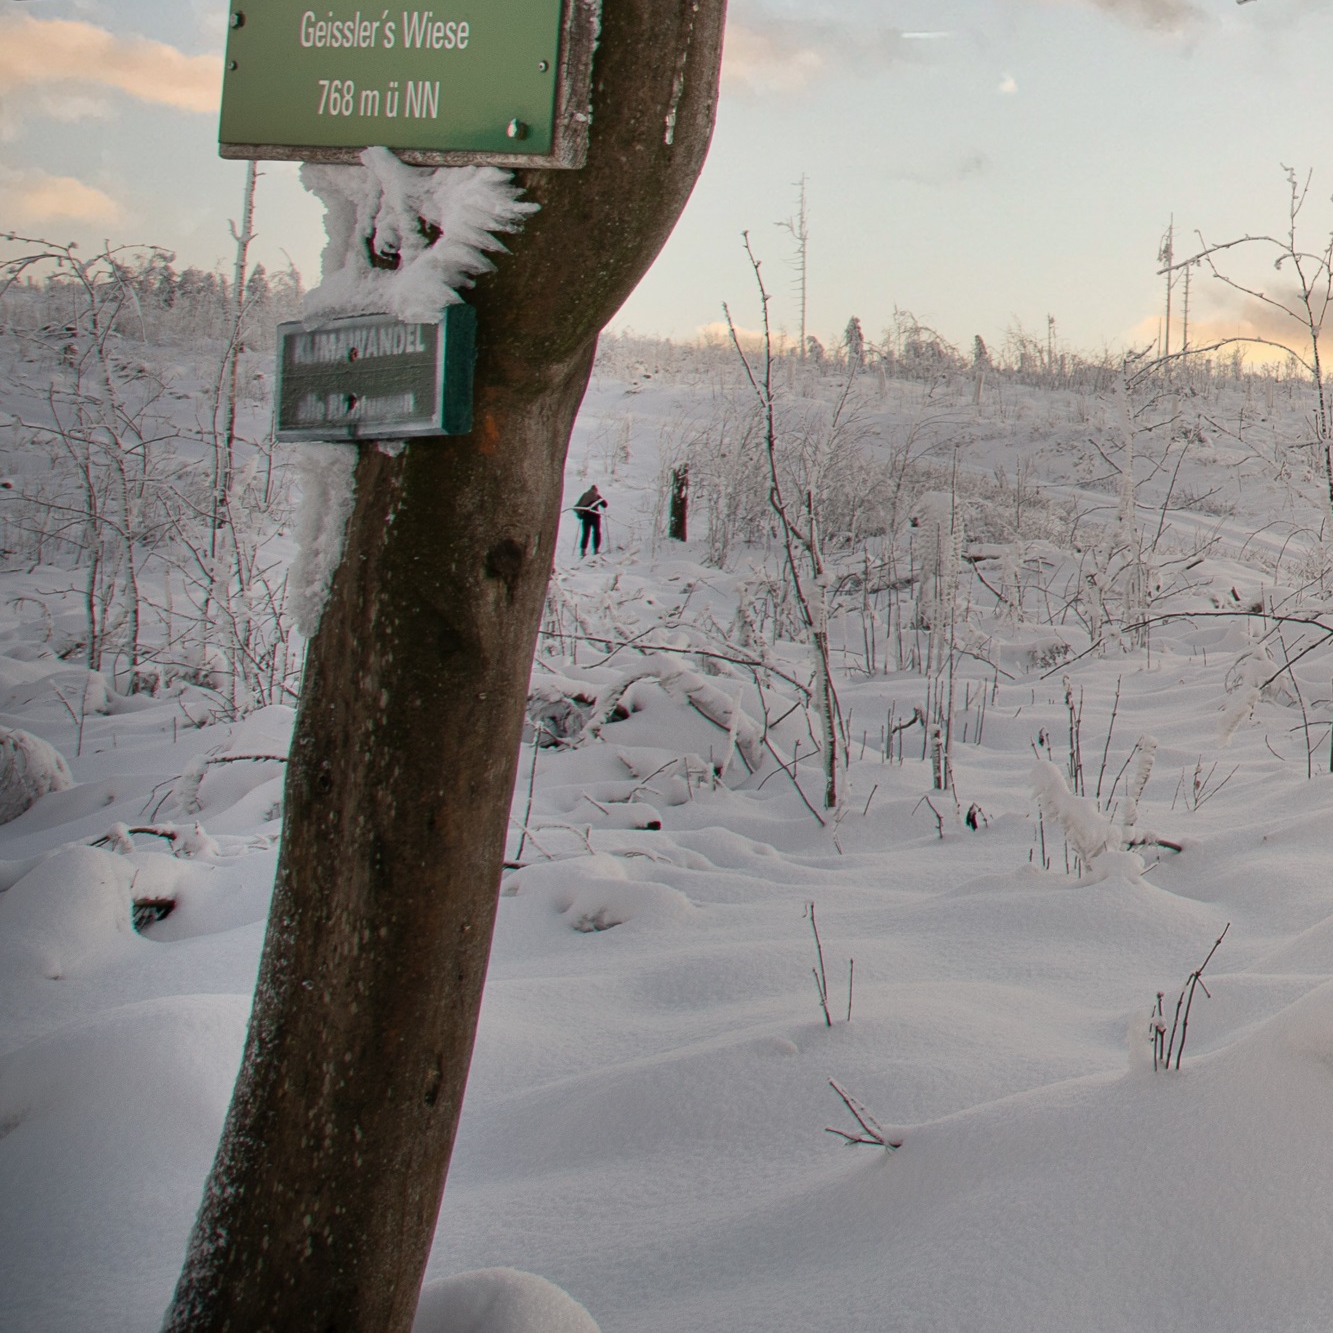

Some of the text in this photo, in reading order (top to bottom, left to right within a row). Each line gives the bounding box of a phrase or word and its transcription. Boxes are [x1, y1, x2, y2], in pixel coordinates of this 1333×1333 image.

[402, 10, 470, 50] Wiese
[316, 78, 441, 119] 768 m ü NN
[294, 324, 425, 364] KLIMAWANDEL
